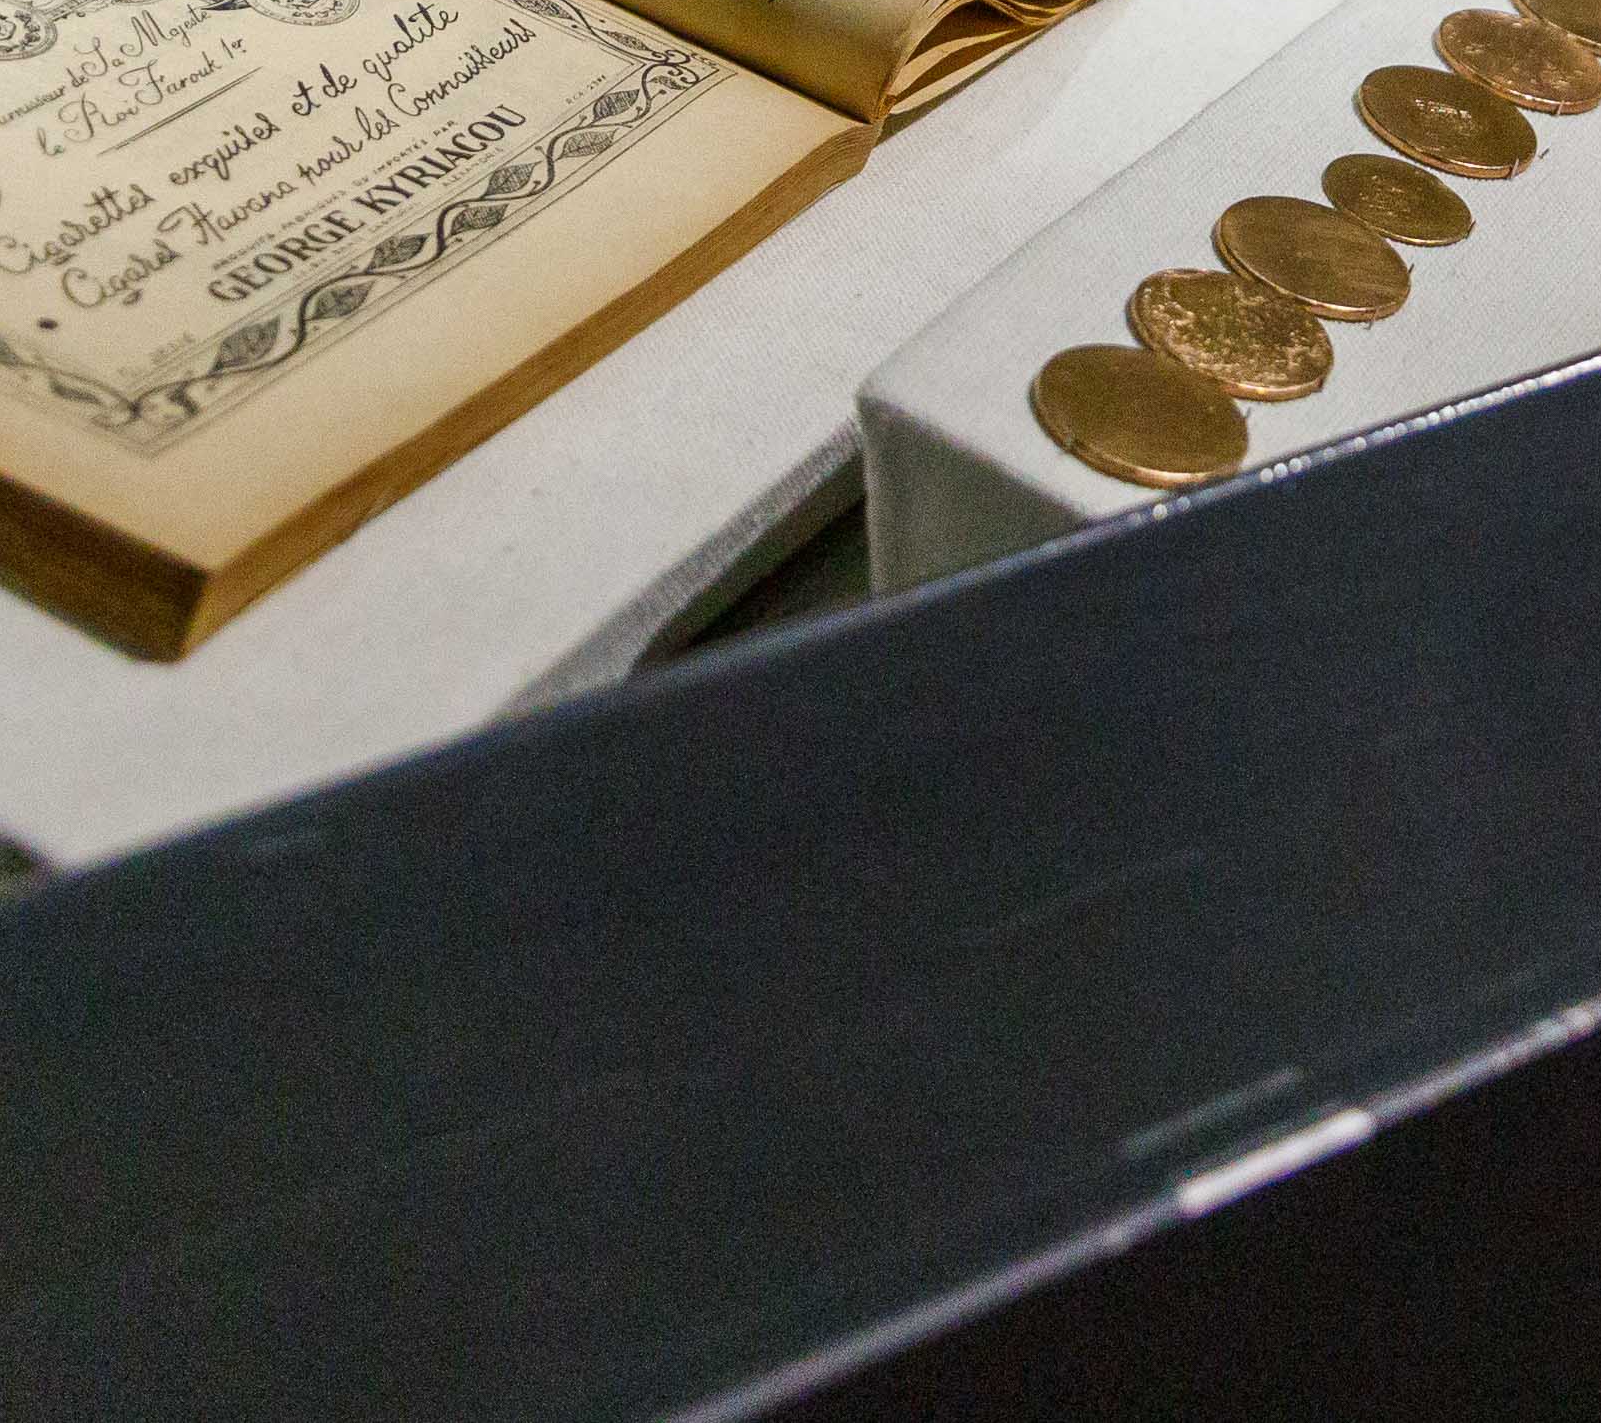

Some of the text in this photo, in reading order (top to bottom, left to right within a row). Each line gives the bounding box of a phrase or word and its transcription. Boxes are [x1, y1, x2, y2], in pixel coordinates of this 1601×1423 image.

[36, 128, 66, 158] le
[57, 92, 140, 142] Roi
[117, 51, 221, 107] Farouk
[61, 239, 183, 309] Cigares
[156, 172, 298, 246] Havana
[297, 135, 364, 185] pour
[354, 106, 400, 141] les
[386, 18, 537, 117] Connaisseurs
[169, 112, 281, 186] exquises
[322, 64, 359, 100] de
[208, 210, 365, 302] GEORGE
[353, 104, 526, 215] KYRIACOU
